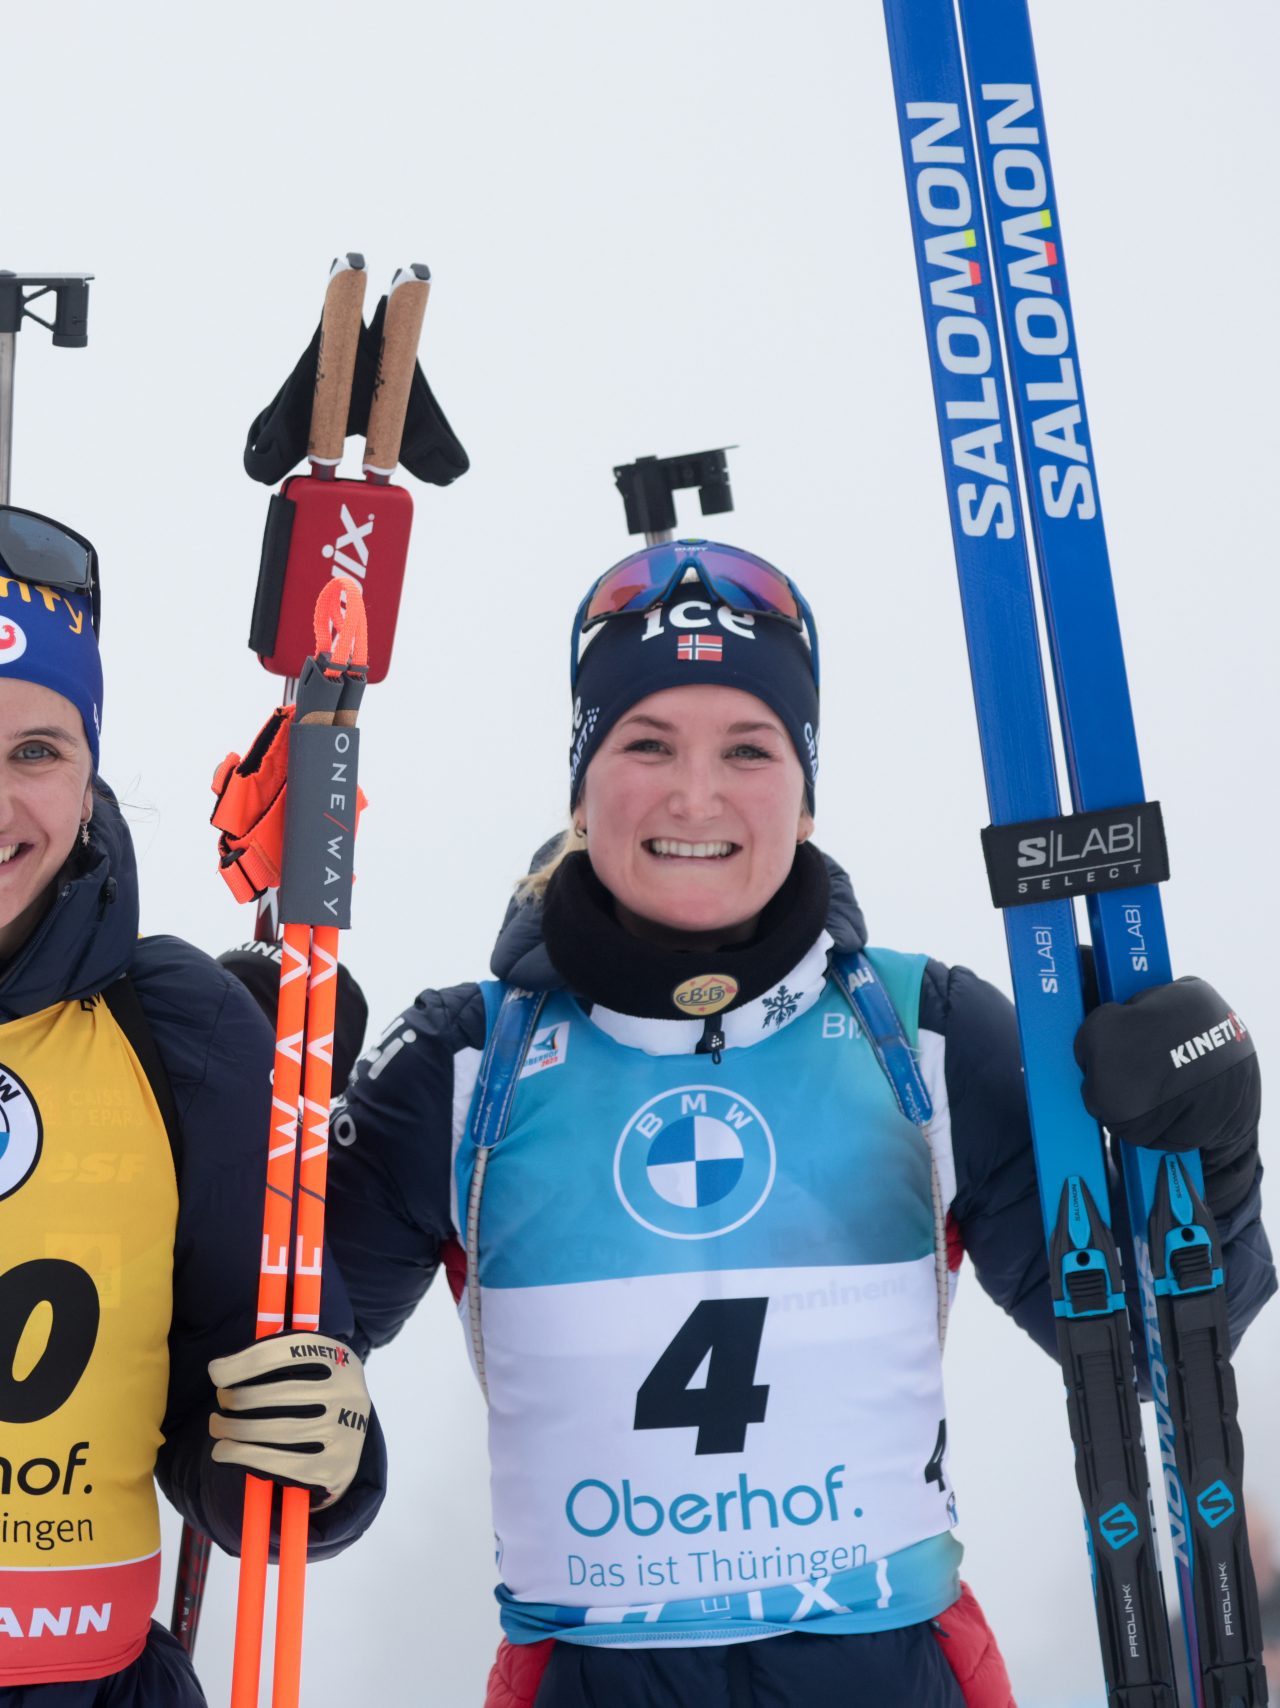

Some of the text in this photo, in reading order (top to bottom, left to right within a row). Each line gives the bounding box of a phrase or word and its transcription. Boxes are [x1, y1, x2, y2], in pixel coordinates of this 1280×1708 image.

[906, 102, 1016, 540] SALOMON
[980, 83, 1096, 520] SALOMON
[1018, 864, 1142, 893] SELECT
[635, 1092, 754, 1139] BMW
[633, 1297, 771, 1456] 4
[1134, 1234, 1189, 1569] SALOMON
[567, 1543, 868, 1587] Das ist Thüringen
[1219, 1562, 1235, 1636] PROLINK
[1122, 1584, 1140, 1658] PROLINK
